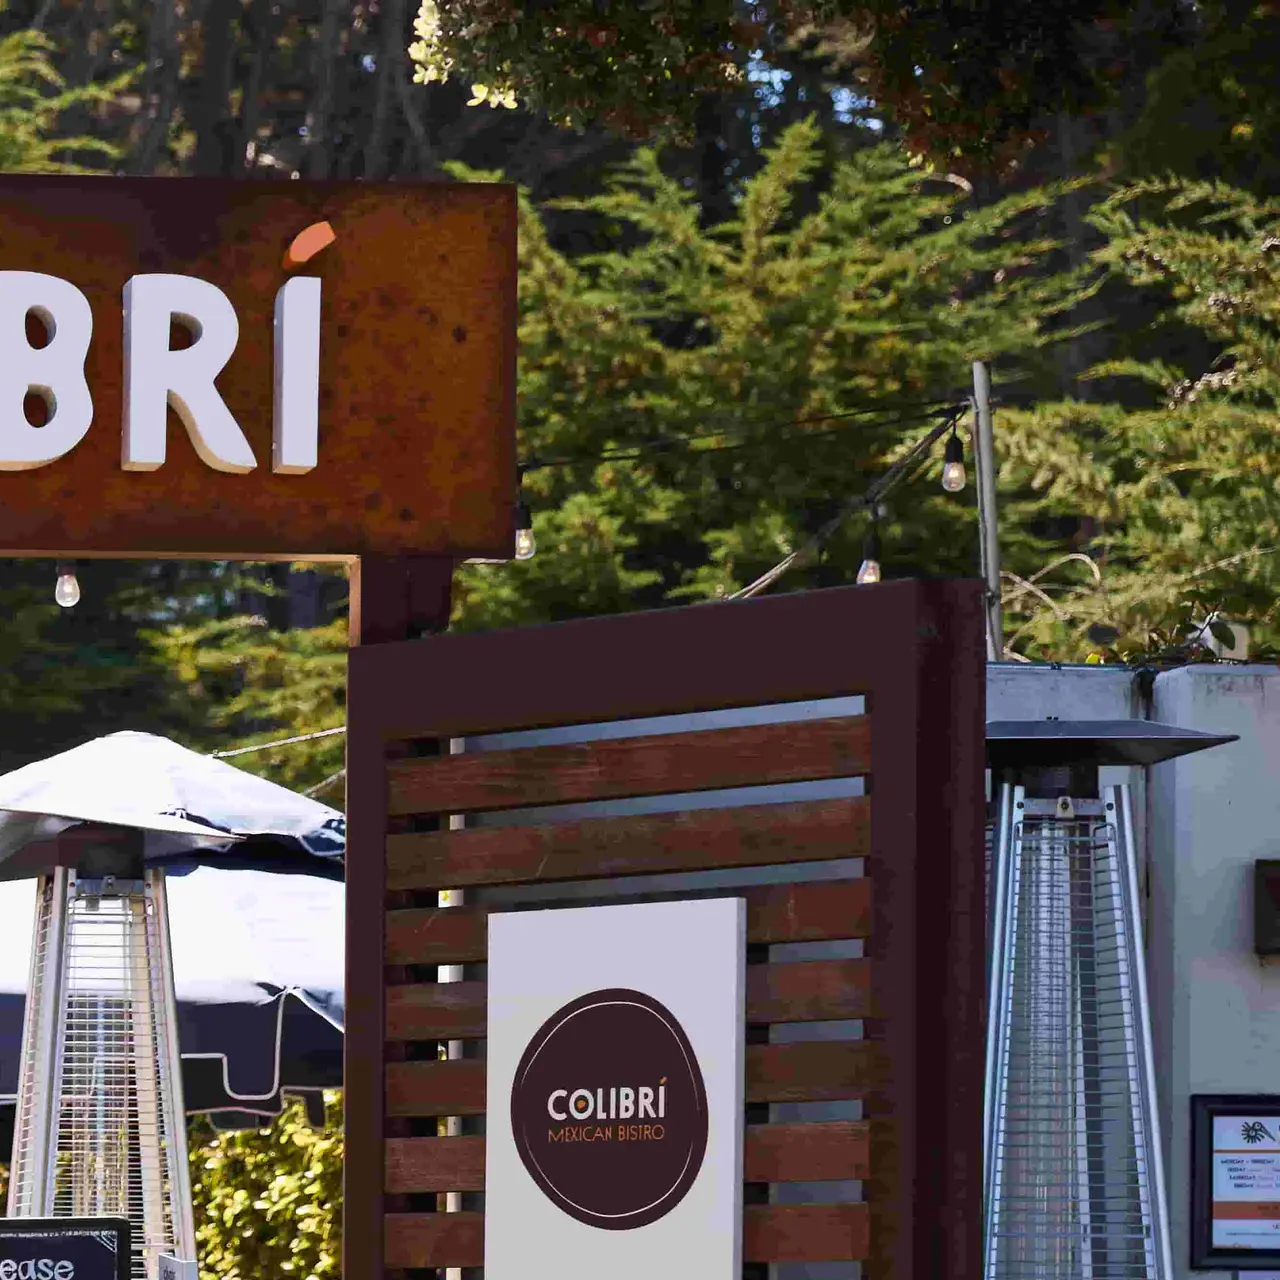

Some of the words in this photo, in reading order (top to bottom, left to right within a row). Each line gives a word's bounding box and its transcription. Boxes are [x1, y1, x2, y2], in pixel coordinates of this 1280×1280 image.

[547, 1076, 668, 1121] COLIBRÍ
[548, 1125, 613, 1143] MEXICAN
[617, 1124, 666, 1142] BISTRO
